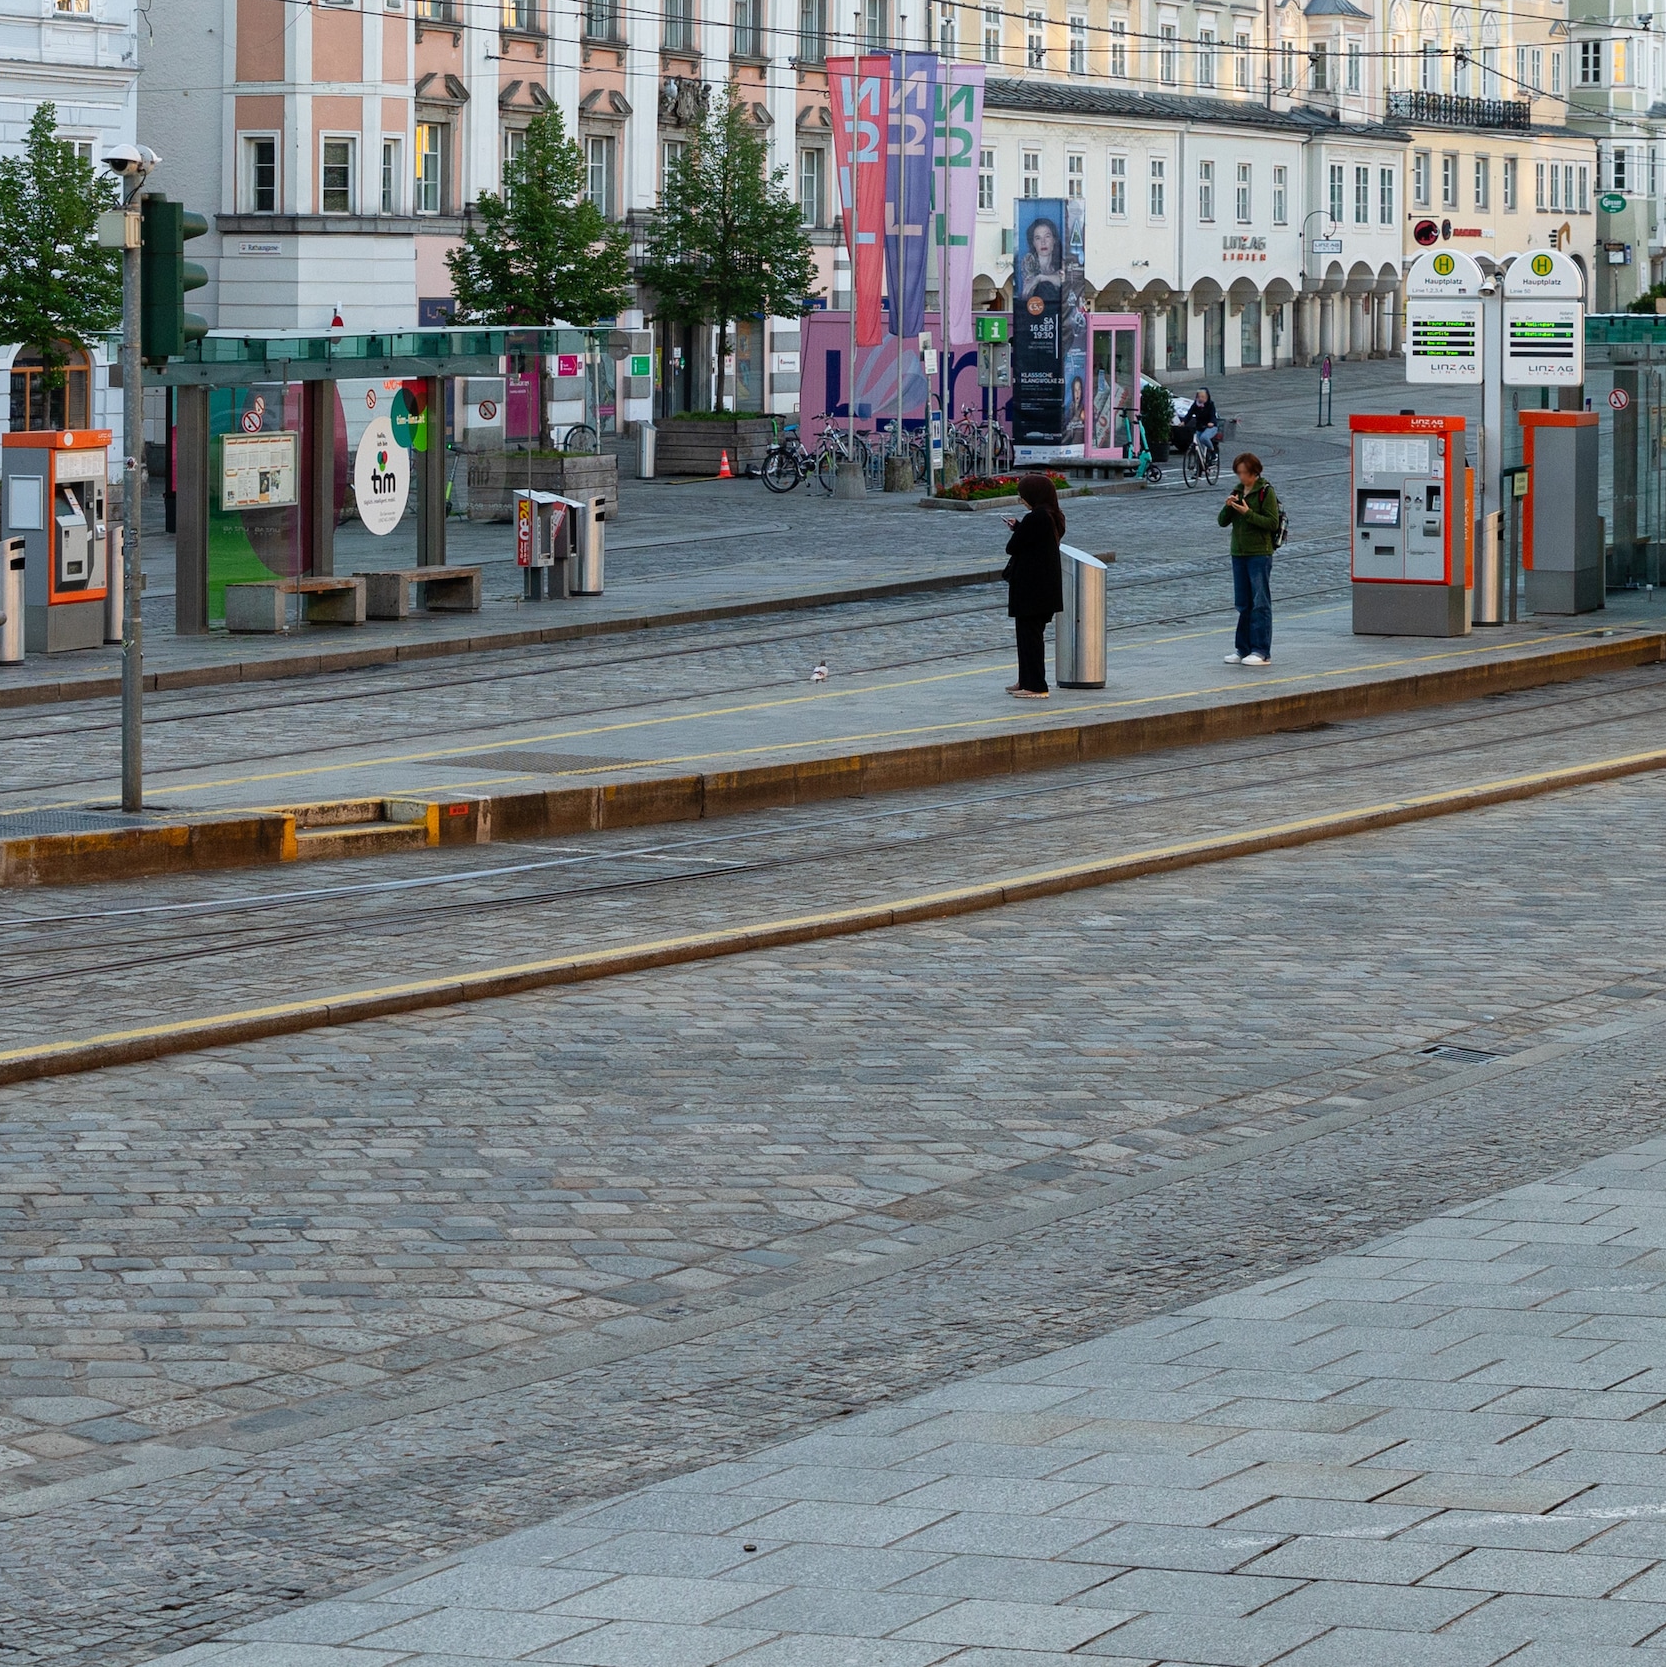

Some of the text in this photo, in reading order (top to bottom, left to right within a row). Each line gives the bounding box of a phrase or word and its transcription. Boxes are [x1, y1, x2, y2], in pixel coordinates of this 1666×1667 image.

[1223, 236, 1247, 250] LINZ
[1223, 253, 1266, 261] LINIEN
[1425, 278, 1463, 286] Hauptplatz
[1522, 279, 1561, 287] Hauptplatz
[371, 468, 396, 494] tim
